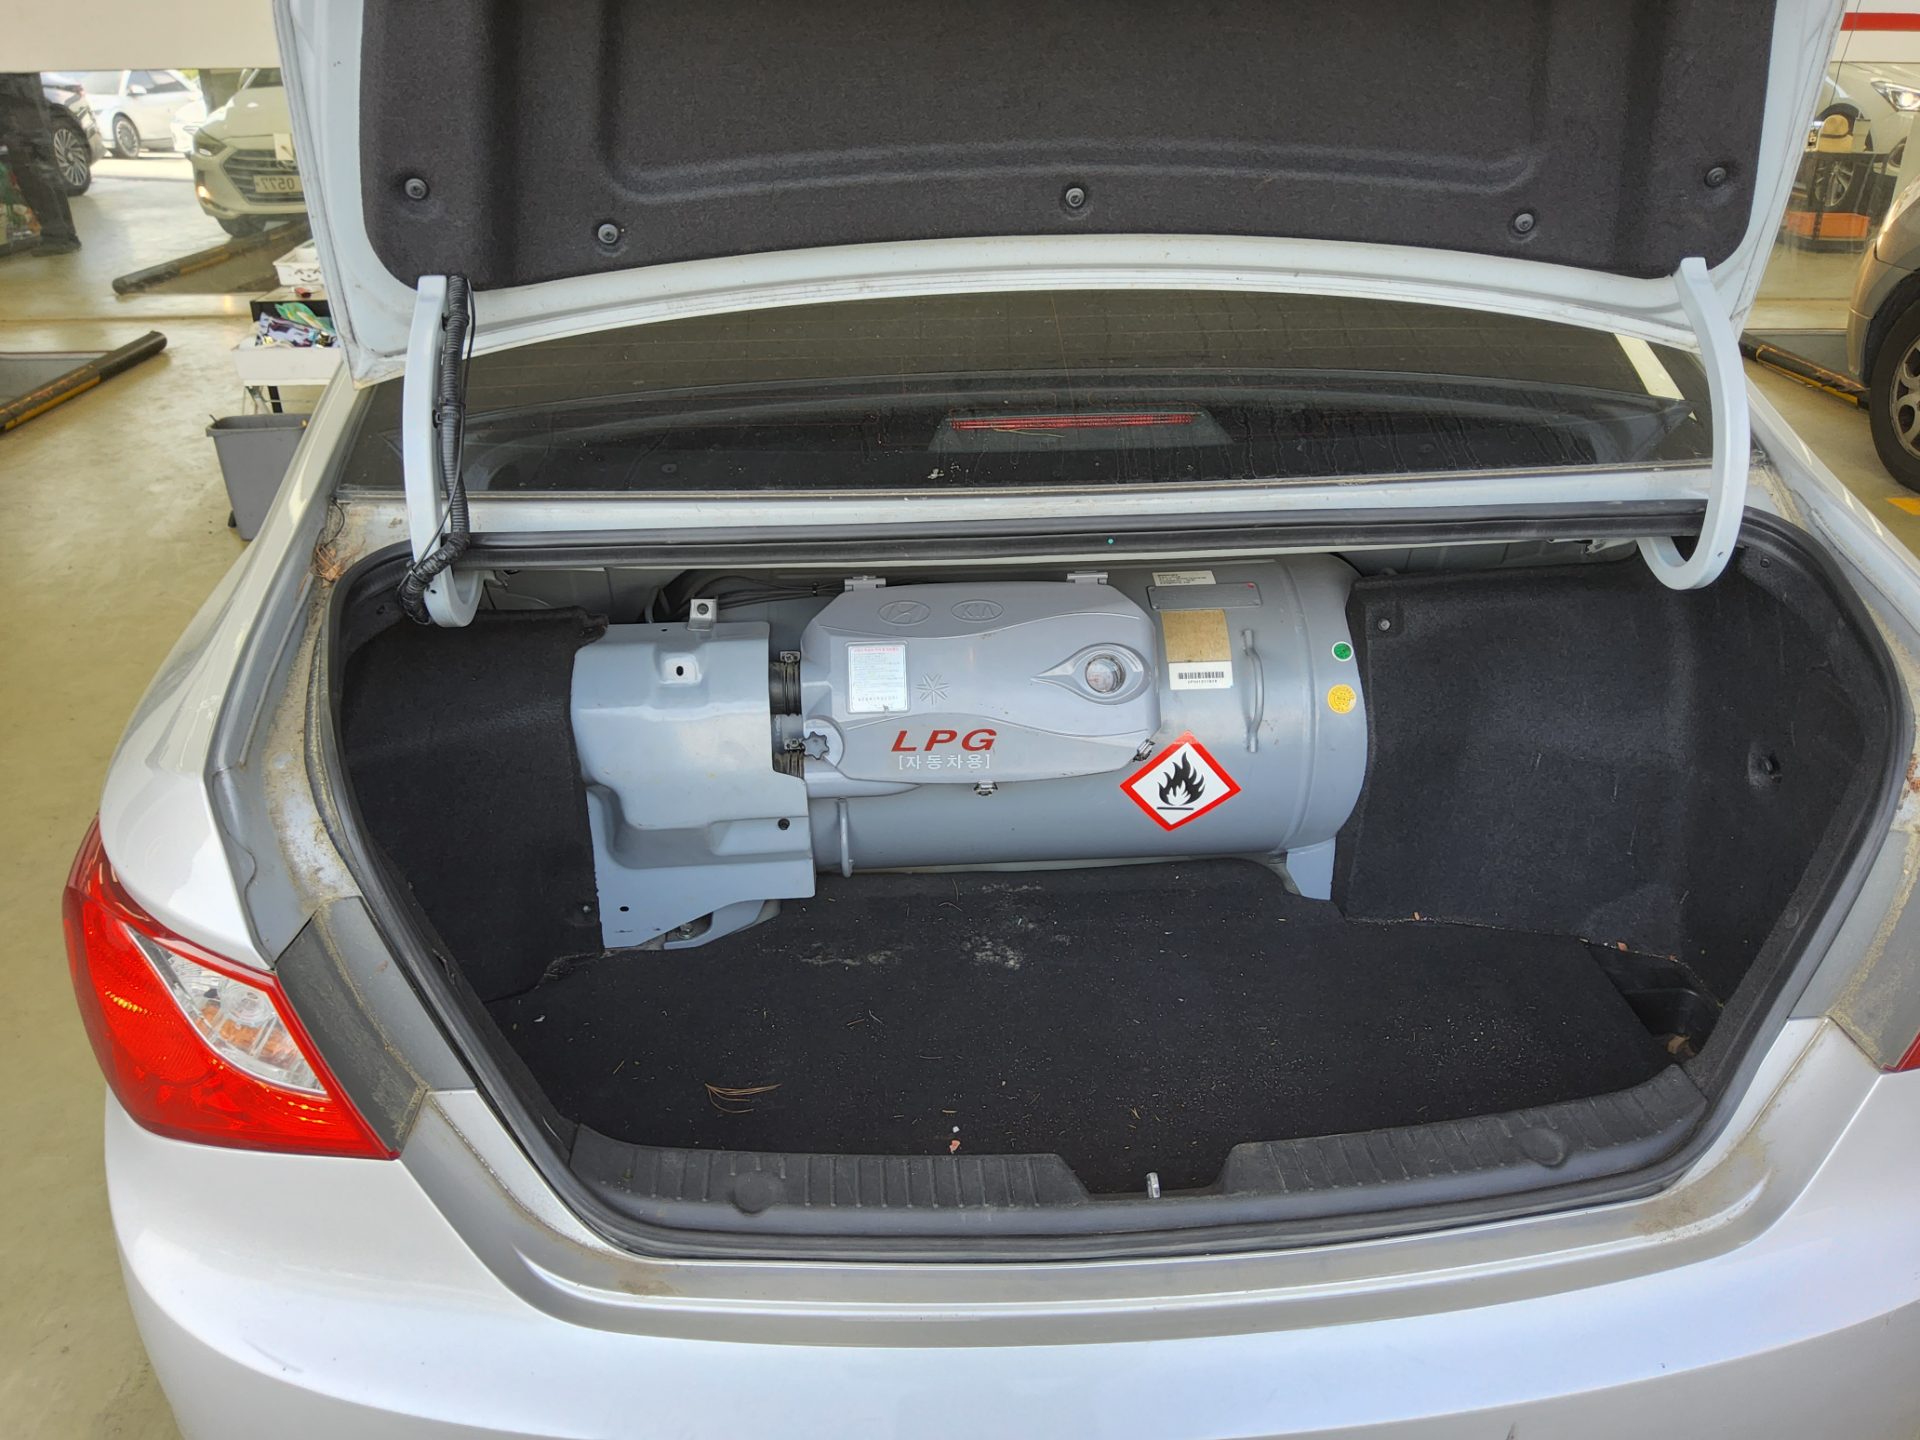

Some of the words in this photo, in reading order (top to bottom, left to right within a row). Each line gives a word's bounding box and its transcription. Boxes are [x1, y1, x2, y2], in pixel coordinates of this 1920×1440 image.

[961, 603, 996, 618] KIA
[891, 728, 997, 752] LPG
[899, 753, 990, 770] [자동차용]
